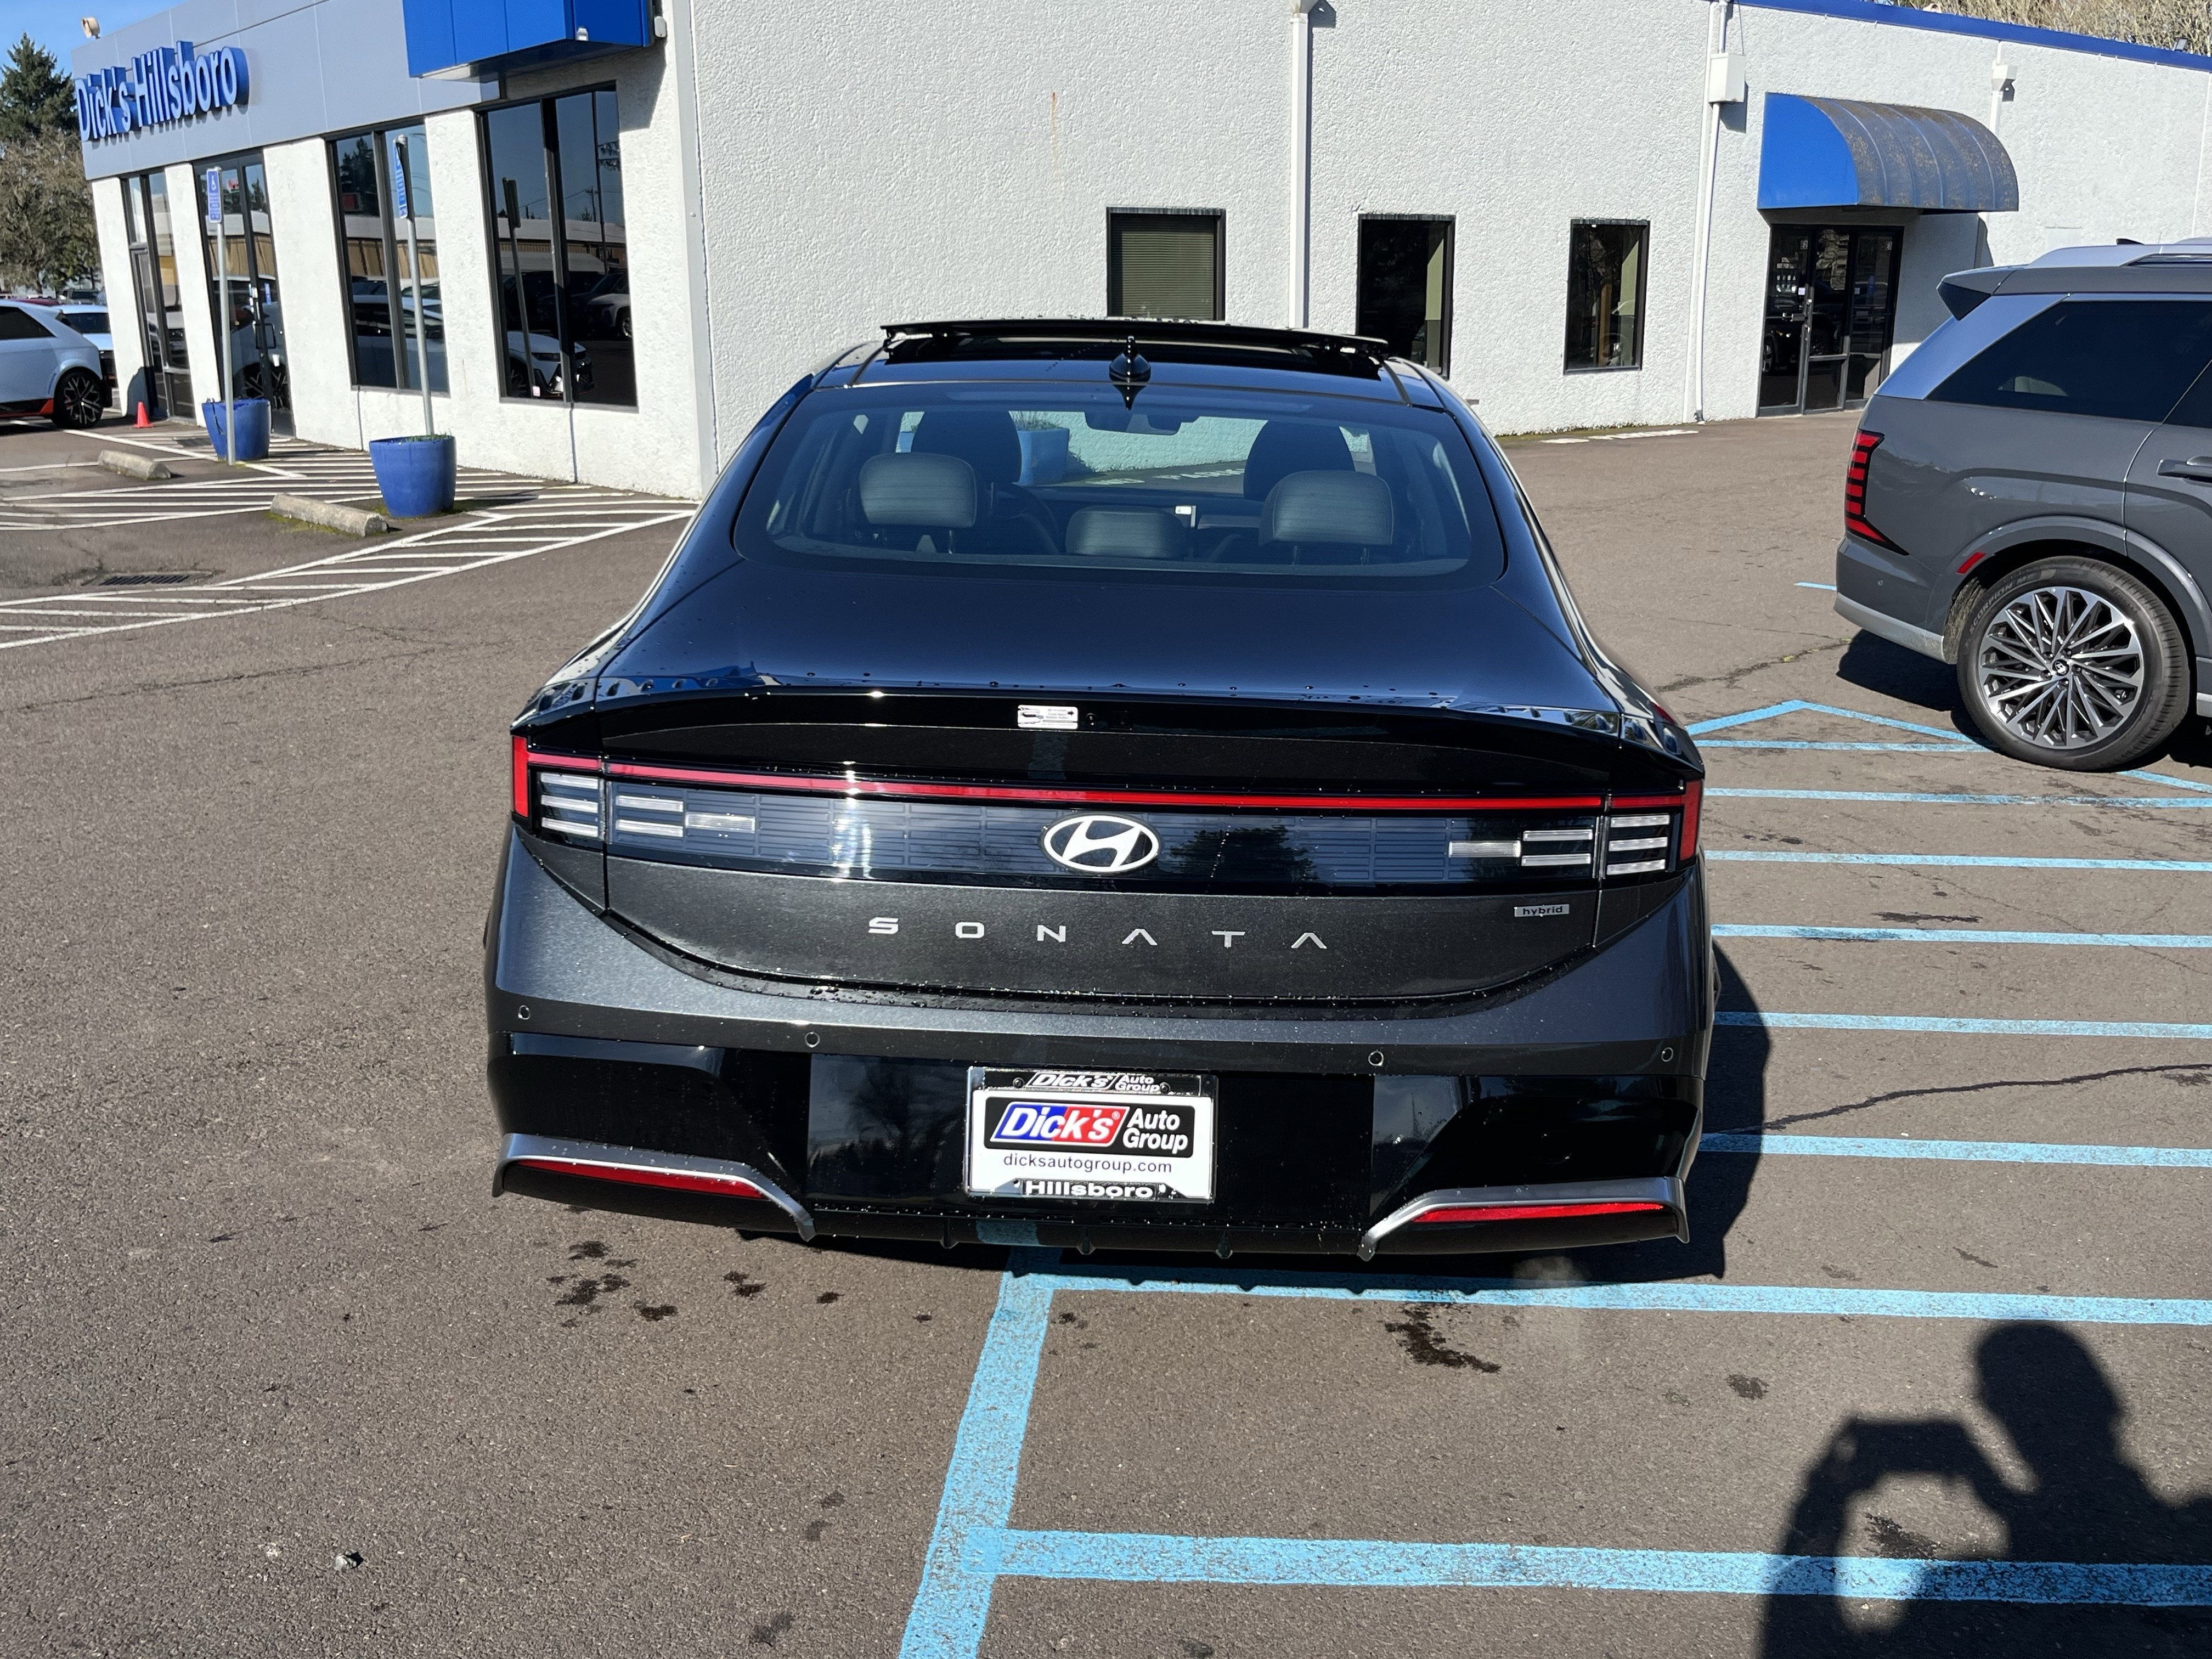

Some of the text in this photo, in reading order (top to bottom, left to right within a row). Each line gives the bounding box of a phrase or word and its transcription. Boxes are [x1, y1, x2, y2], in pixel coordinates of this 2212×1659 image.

[75, 41, 240, 142] Dick's Hillsboro
[1522, 906, 1563, 916] hybrid
[868, 917, 1328, 950] SONATA
[1114, 1082, 1161, 1093] Group
[1118, 1074, 1154, 1085] Auto
[1127, 1108, 1180, 1131] Auto
[1122, 1127, 1189, 1154] Group
[1003, 1153, 1172, 1175] dicksautogroup.com
[1024, 1180, 1154, 1198] Hillsboro
